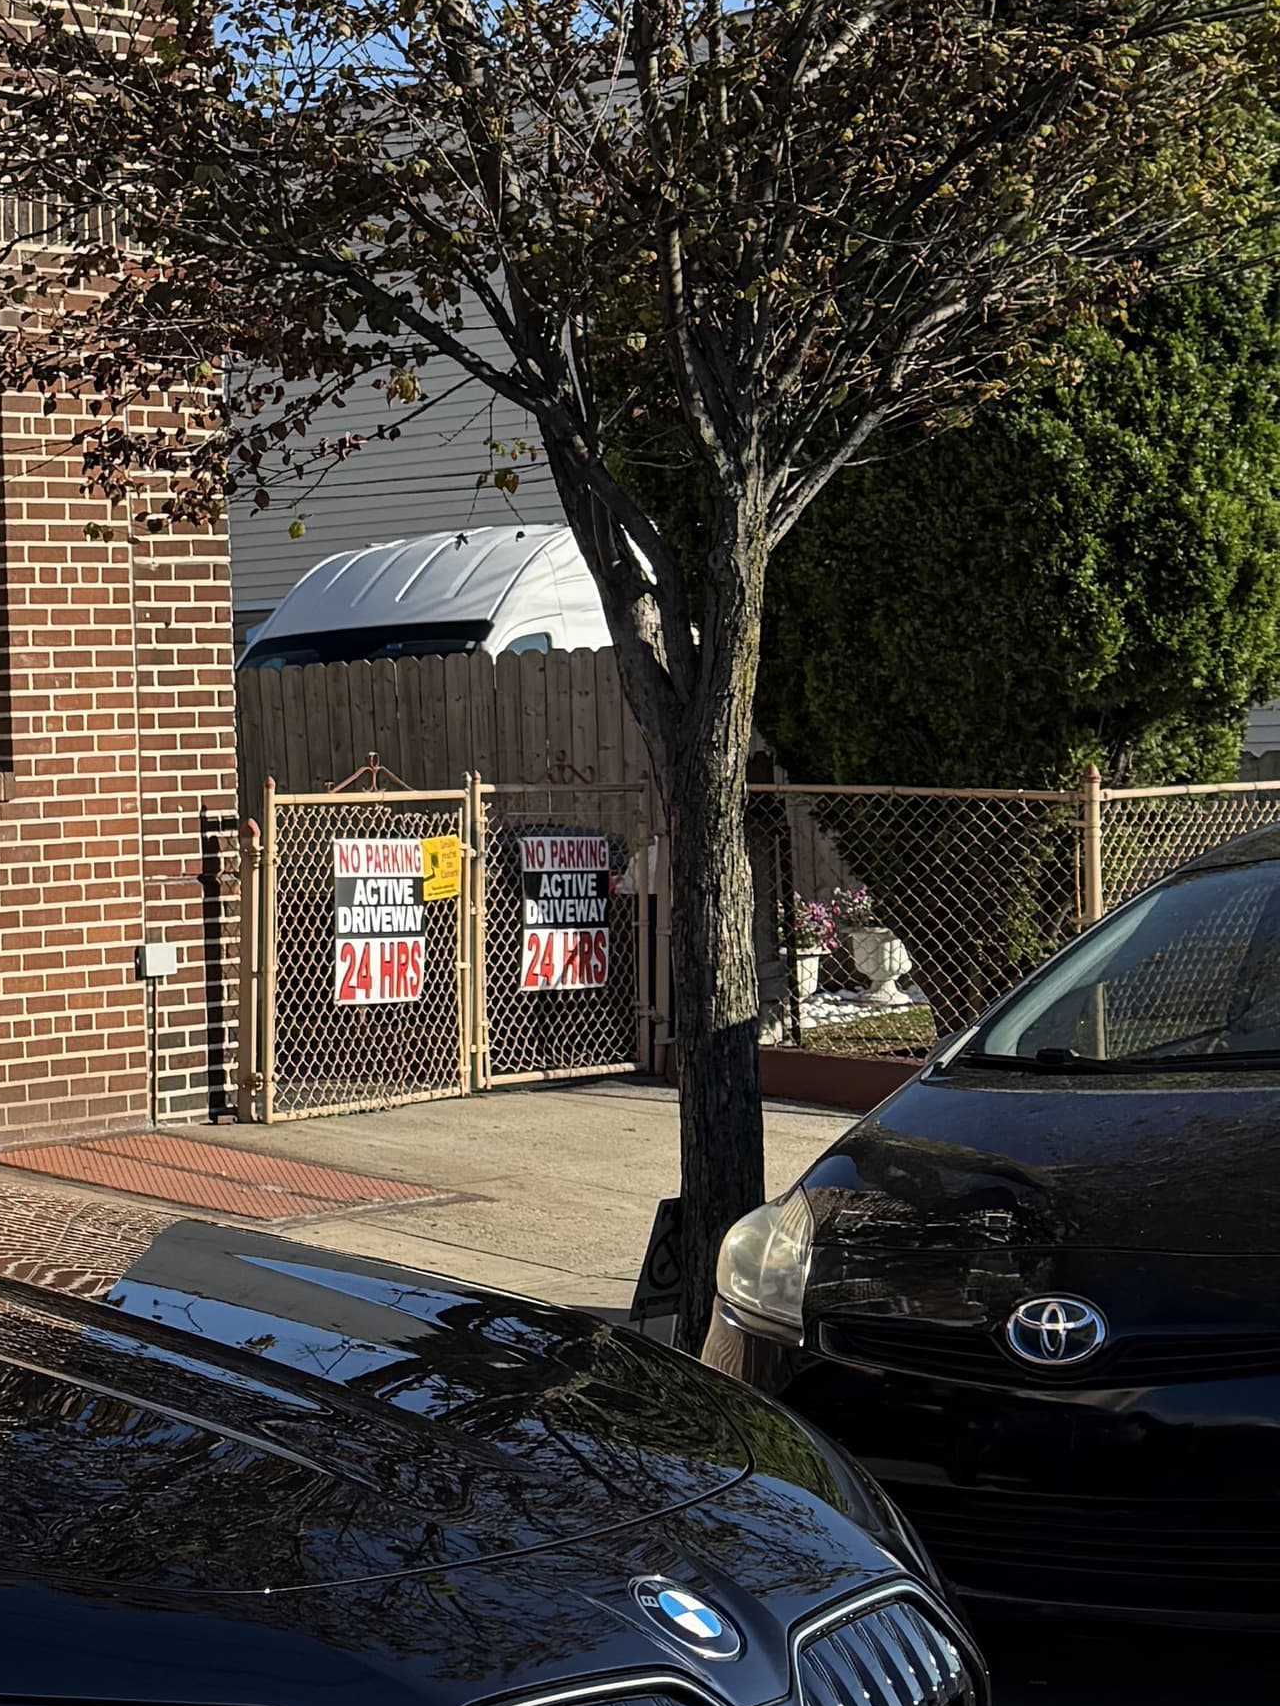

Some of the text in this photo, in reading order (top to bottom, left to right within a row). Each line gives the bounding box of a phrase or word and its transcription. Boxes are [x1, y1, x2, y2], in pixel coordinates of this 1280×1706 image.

[340, 843, 361, 874] NO
[365, 843, 421, 874] PARKING
[524, 839, 607, 869] NO PARKING
[353, 878, 414, 905] ACTIVE
[539, 873, 598, 898] ACTIVE
[338, 905, 425, 934] DRIVEWAY
[525, 898, 608, 925] DRIVEWAY
[339, 940, 422, 1000] 24 HRS
[524, 929, 607, 987] 24 HRS
